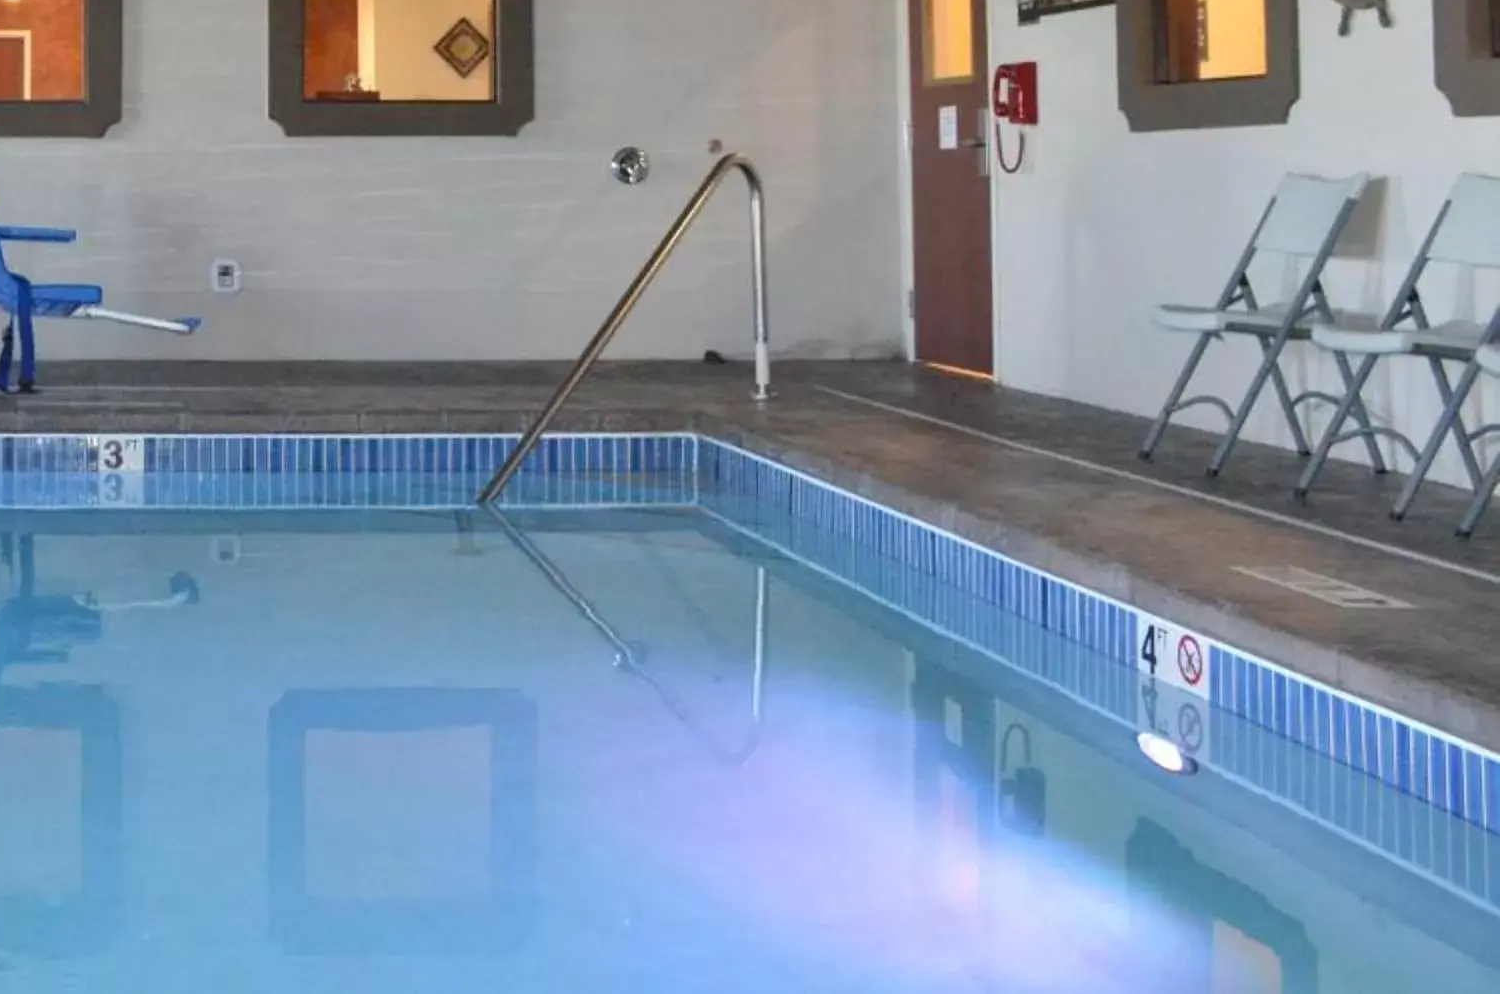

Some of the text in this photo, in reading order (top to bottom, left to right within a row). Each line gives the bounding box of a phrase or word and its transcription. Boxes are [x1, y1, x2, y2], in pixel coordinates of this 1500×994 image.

[104, 439, 124, 470] 3
[1142, 624, 1169, 674] 4 FT
